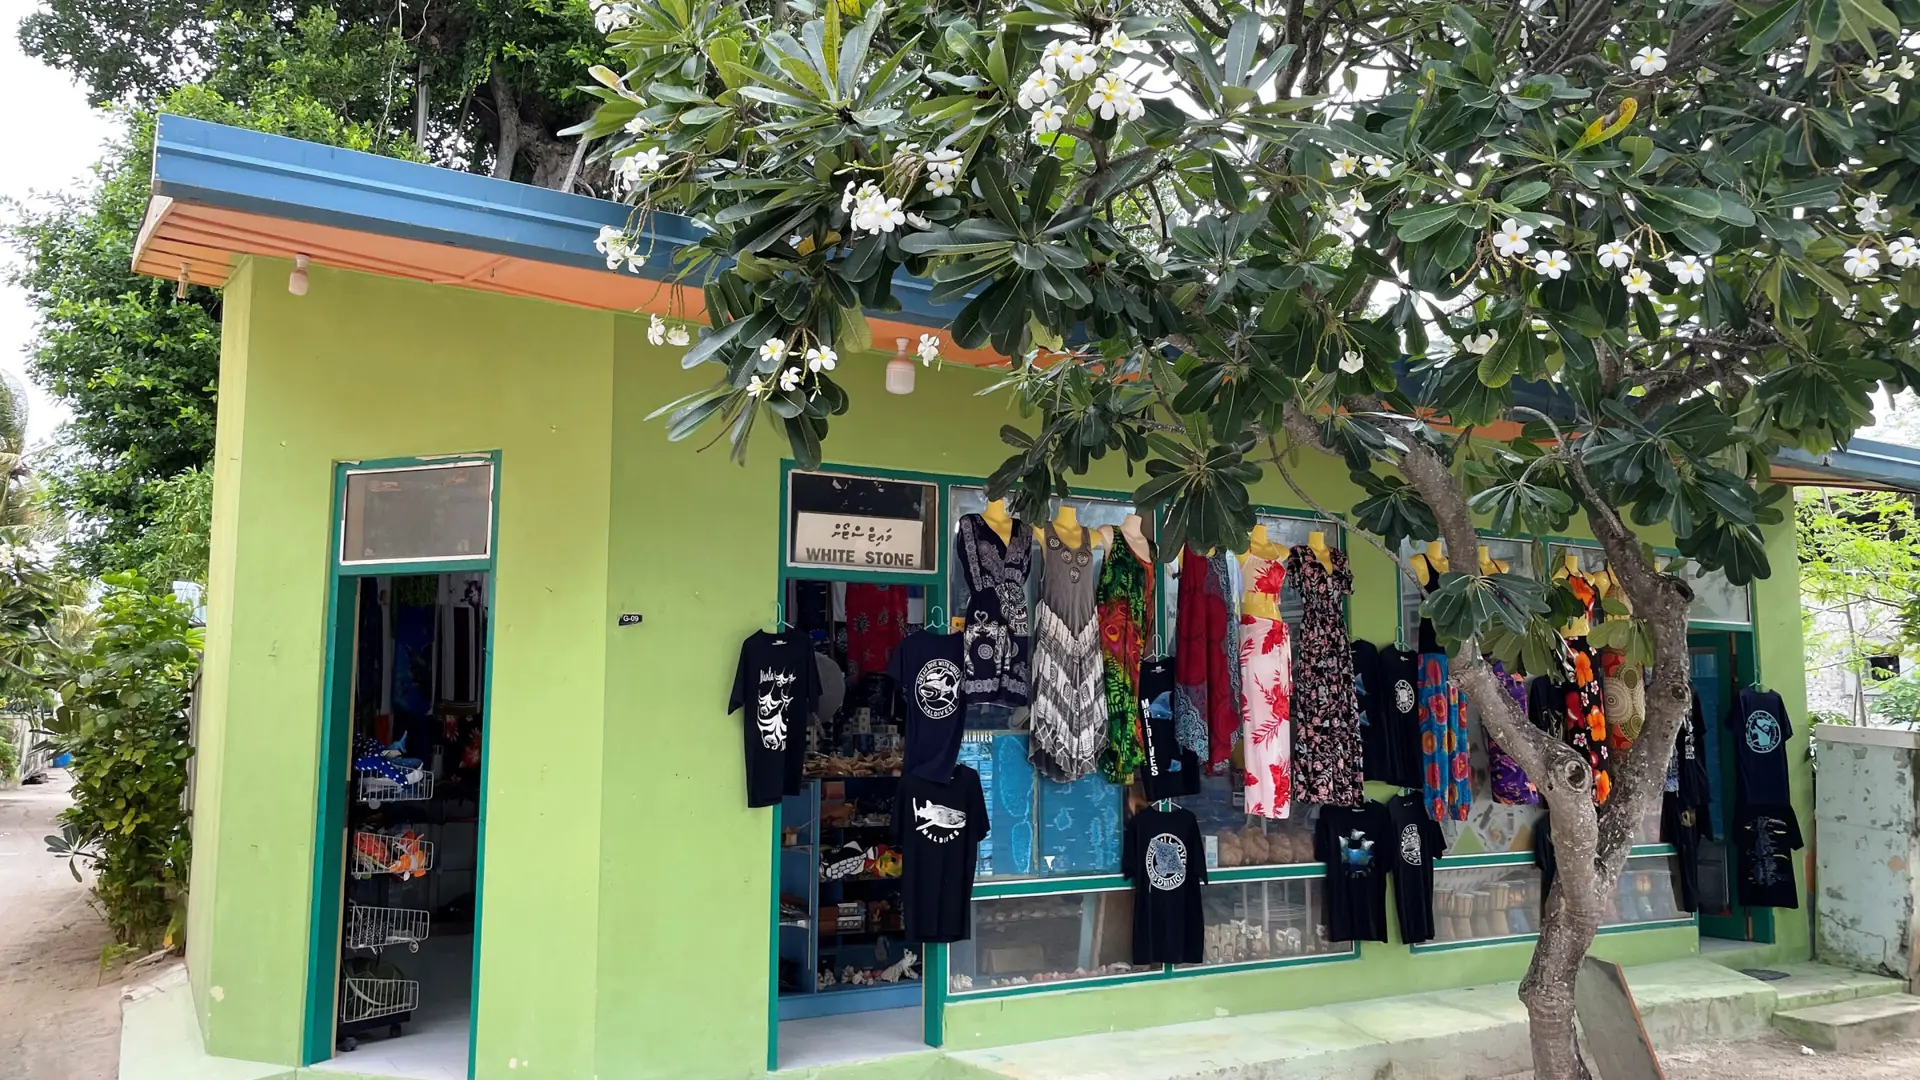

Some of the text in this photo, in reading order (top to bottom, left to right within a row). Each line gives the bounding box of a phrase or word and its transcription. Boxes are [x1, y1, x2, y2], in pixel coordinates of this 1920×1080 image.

[806, 547, 914, 567] WHITE STONE
[622, 615, 639, 623] G-09
[923, 705, 953, 717] MALDIVES
[1141, 698, 1159, 776] MALDIVES
[922, 828, 960, 844] MALDIVES
[1168, 837, 1186, 864] LOVE
[1157, 874, 1182, 888] DIVING
